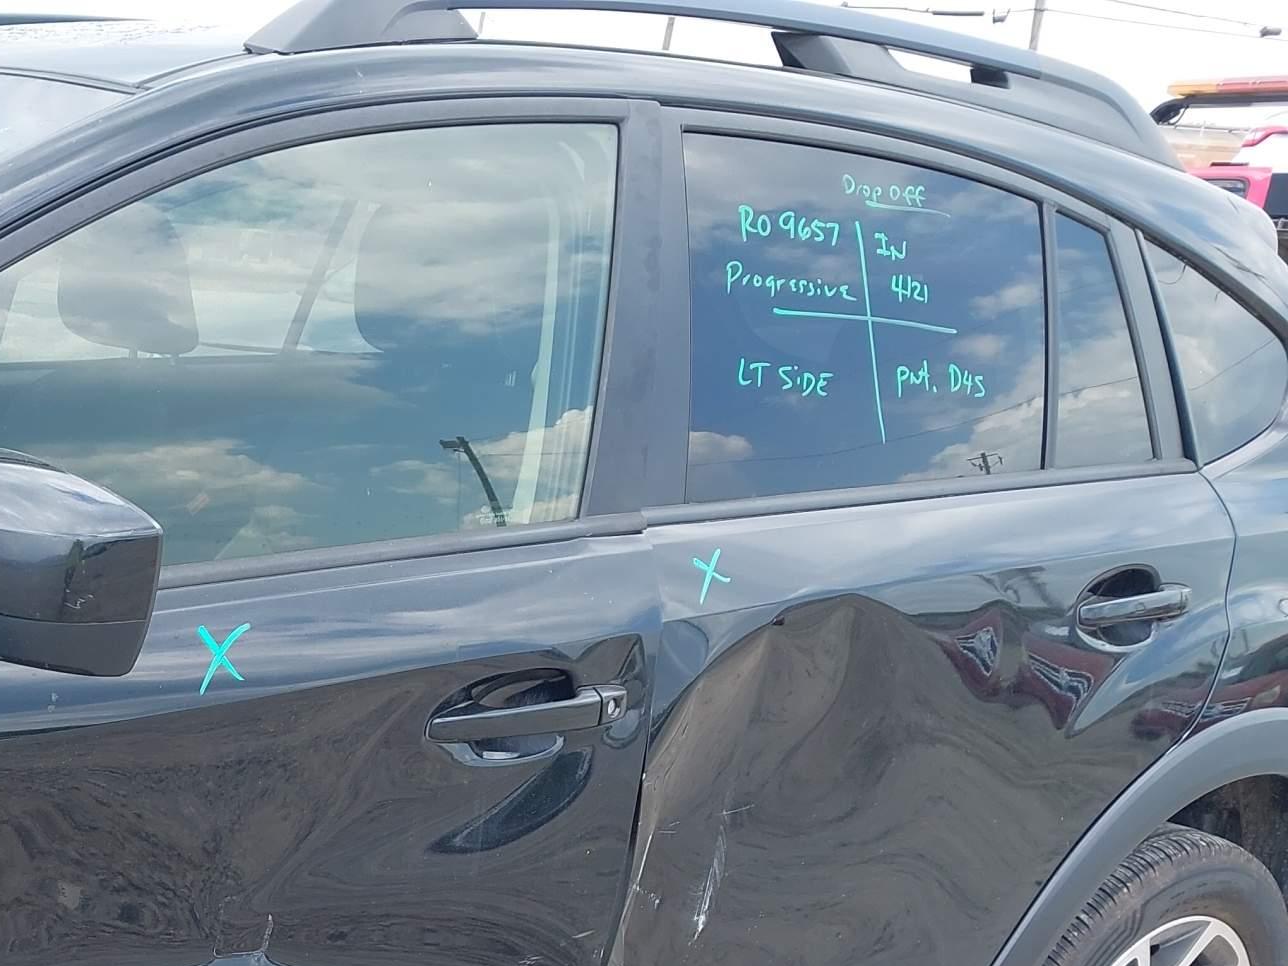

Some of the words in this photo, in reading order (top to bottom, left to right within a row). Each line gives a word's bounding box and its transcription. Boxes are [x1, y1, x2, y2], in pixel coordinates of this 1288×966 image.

[779, 211, 840, 246] 9657
[726, 261, 857, 301] Progressive
[738, 358, 771, 386] LT
